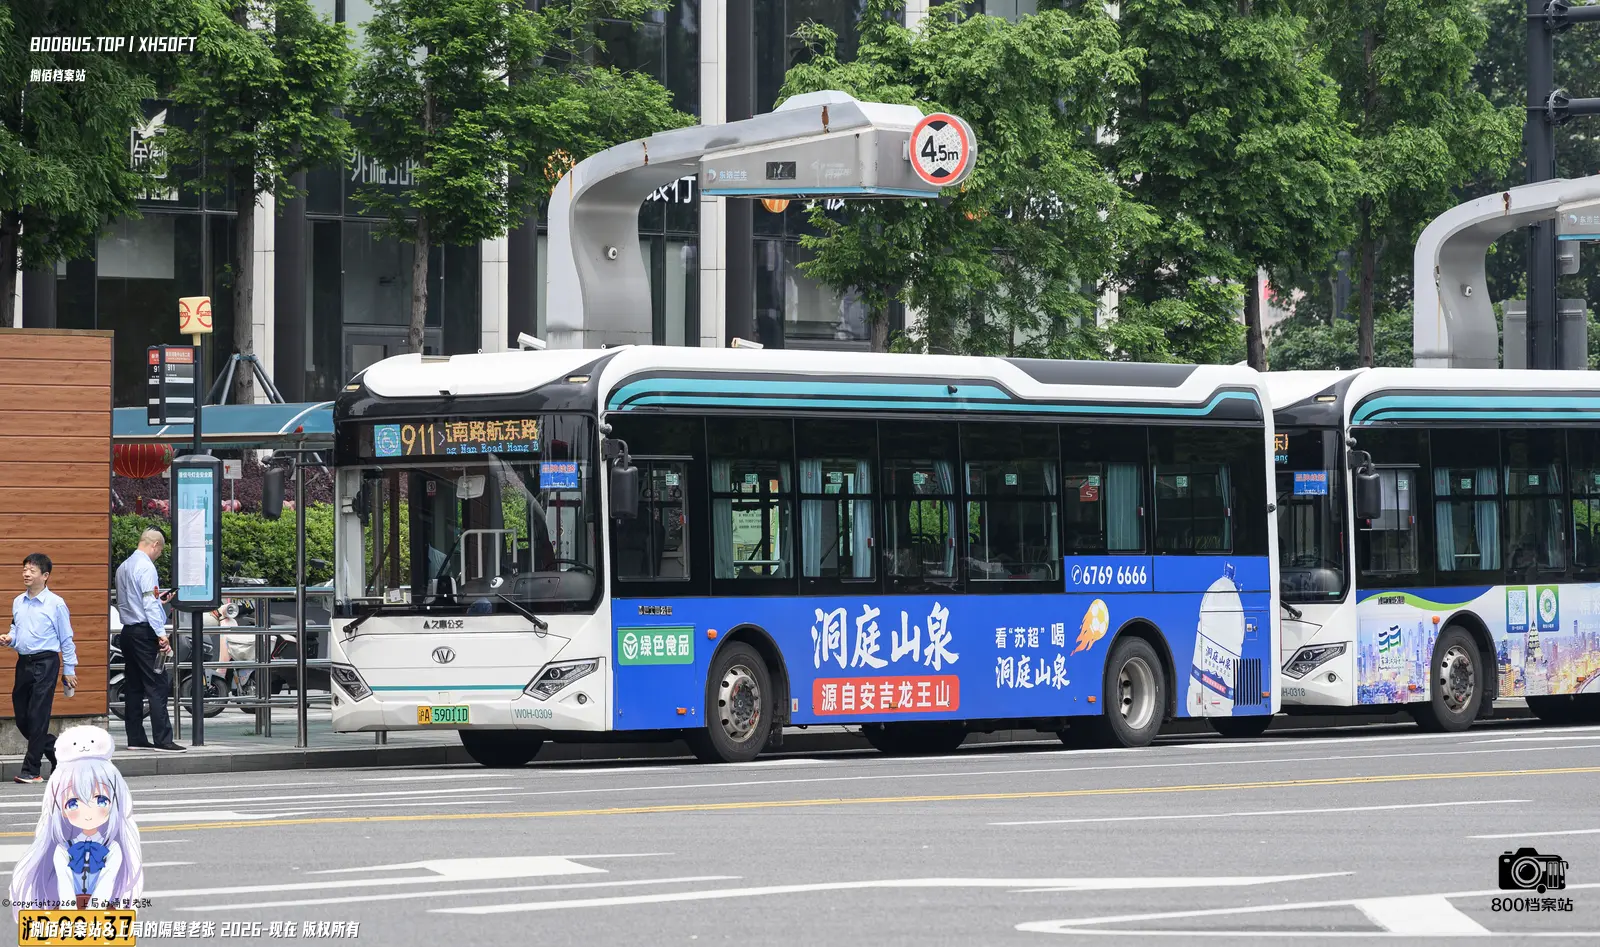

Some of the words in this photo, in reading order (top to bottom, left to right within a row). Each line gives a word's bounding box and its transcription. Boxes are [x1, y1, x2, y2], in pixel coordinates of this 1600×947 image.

[921, 135, 959, 162] 4.5m
[401, 424, 436, 456] 911
[1274, 434, 1289, 452] 东
[1082, 564, 1113, 585] 6769
[1117, 564, 1147, 584] 6666
[640, 632, 690, 657] 绿色食品
[810, 601, 959, 671] 洞庭山泉
[995, 653, 1070, 690] 洞庭山泉
[820, 681, 951, 711] 源自安吉龙王山
